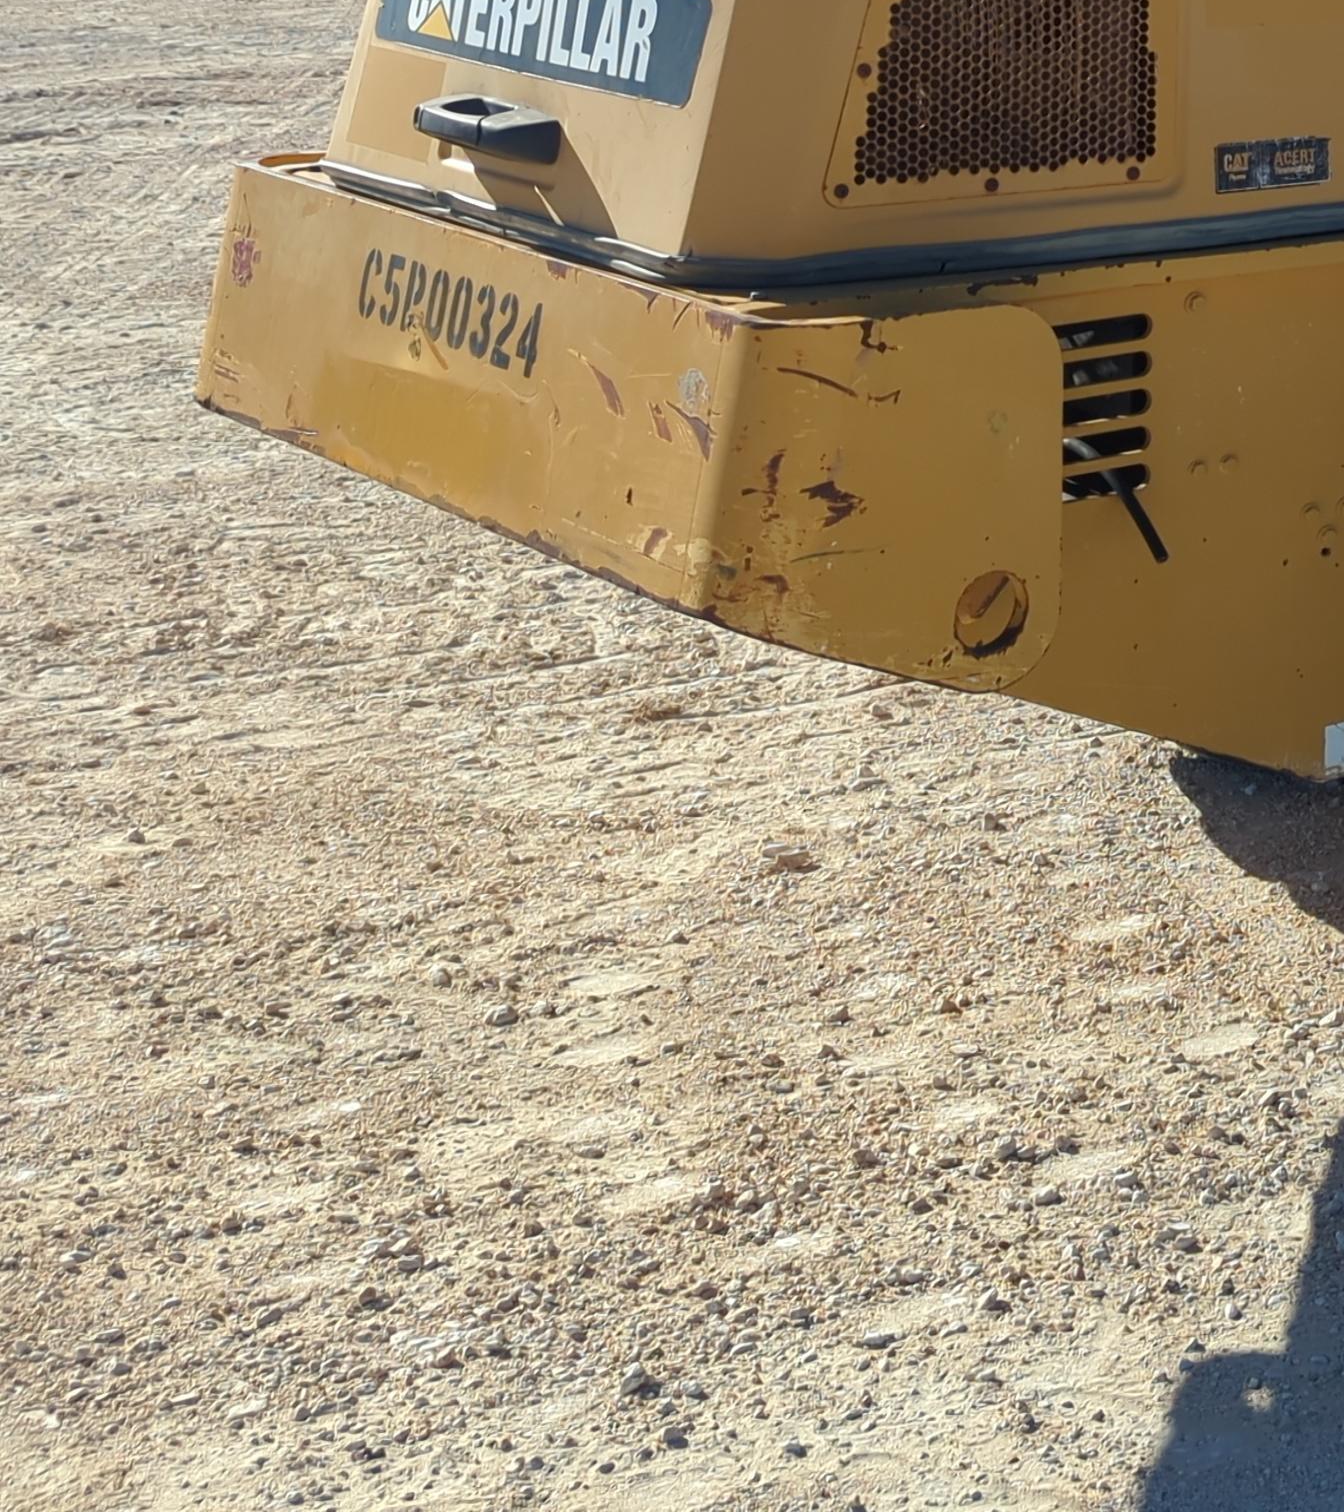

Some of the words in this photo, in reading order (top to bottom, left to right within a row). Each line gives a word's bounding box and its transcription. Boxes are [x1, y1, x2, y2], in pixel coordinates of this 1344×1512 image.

[1223, 152, 1249, 173] CAT
[1275, 148, 1316, 168] ACERT
[357, 247, 544, 379] C5P00324
